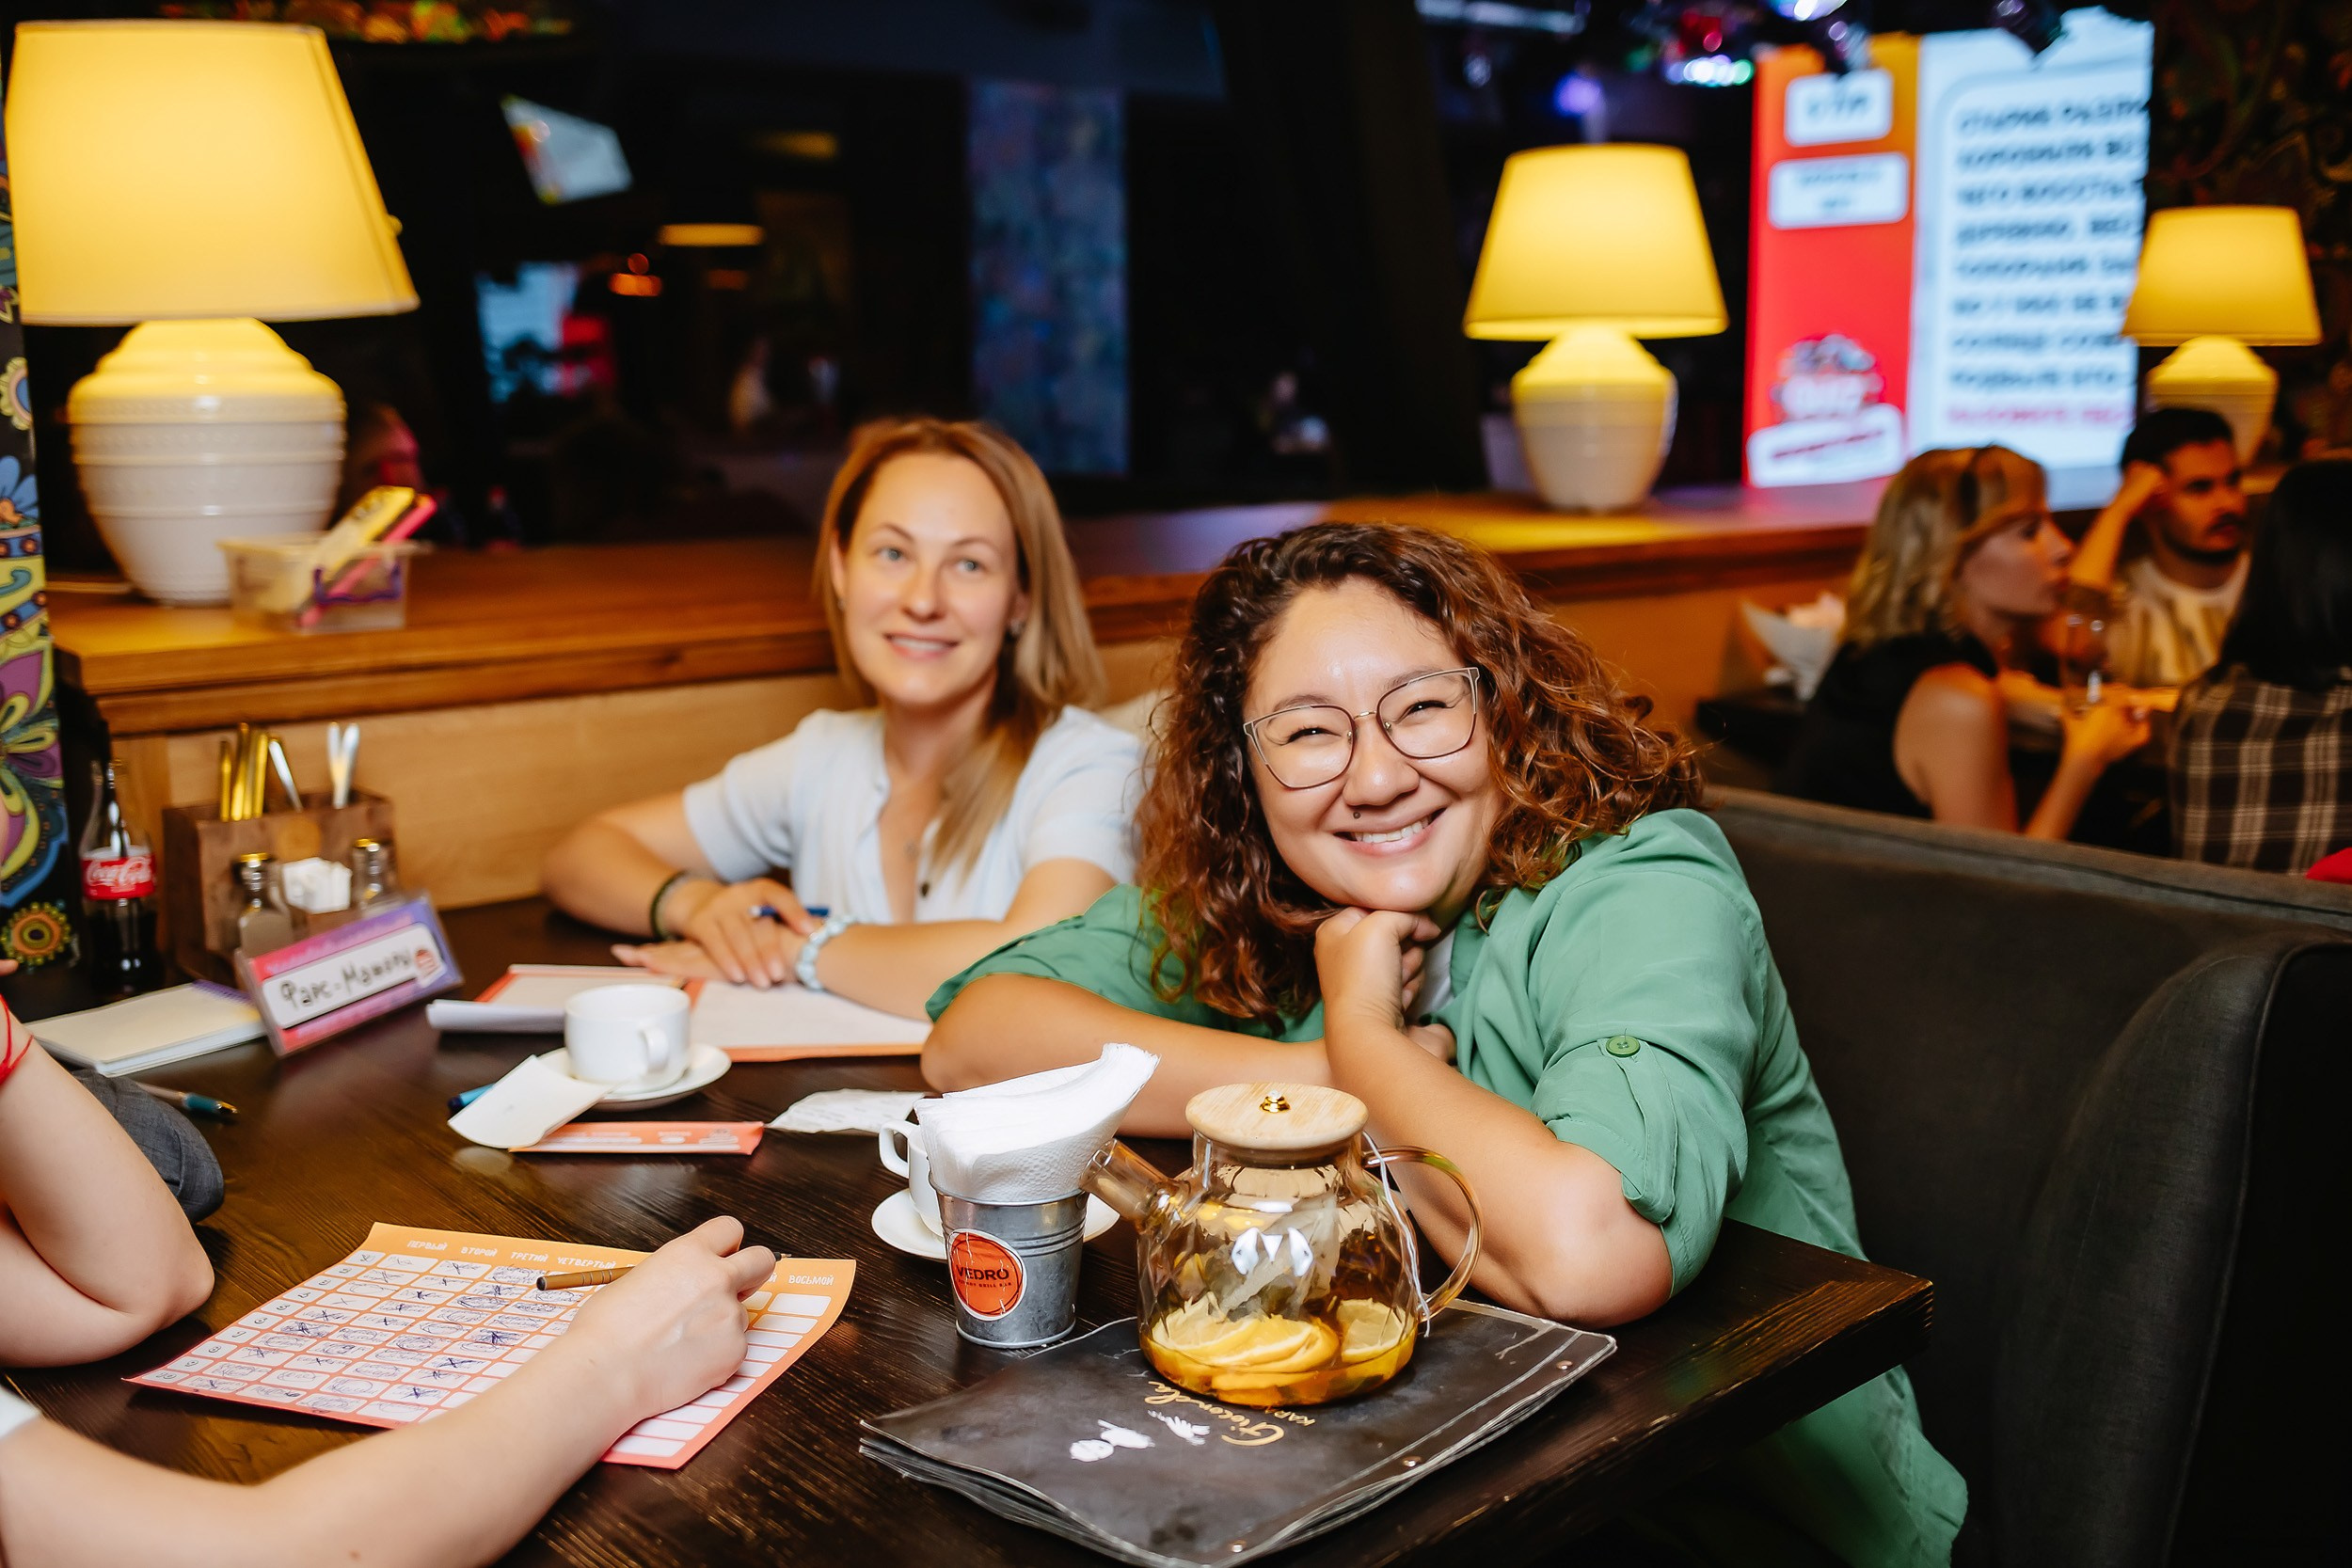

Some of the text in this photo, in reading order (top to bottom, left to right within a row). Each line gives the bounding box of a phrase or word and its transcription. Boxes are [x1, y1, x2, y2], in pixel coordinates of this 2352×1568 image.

[407, 1240, 448, 1251] ПЕРВЫЙ
[461, 1246, 499, 1257] ВТОРОЙ
[511, 1251, 548, 1262] ТРЕТИЙ
[557, 1256, 617, 1269] ЧЕТВЕРТЫЙ
[788, 1275, 834, 1286] ВОСЬМОЙ
[956, 1265, 1009, 1280] VEDRO
